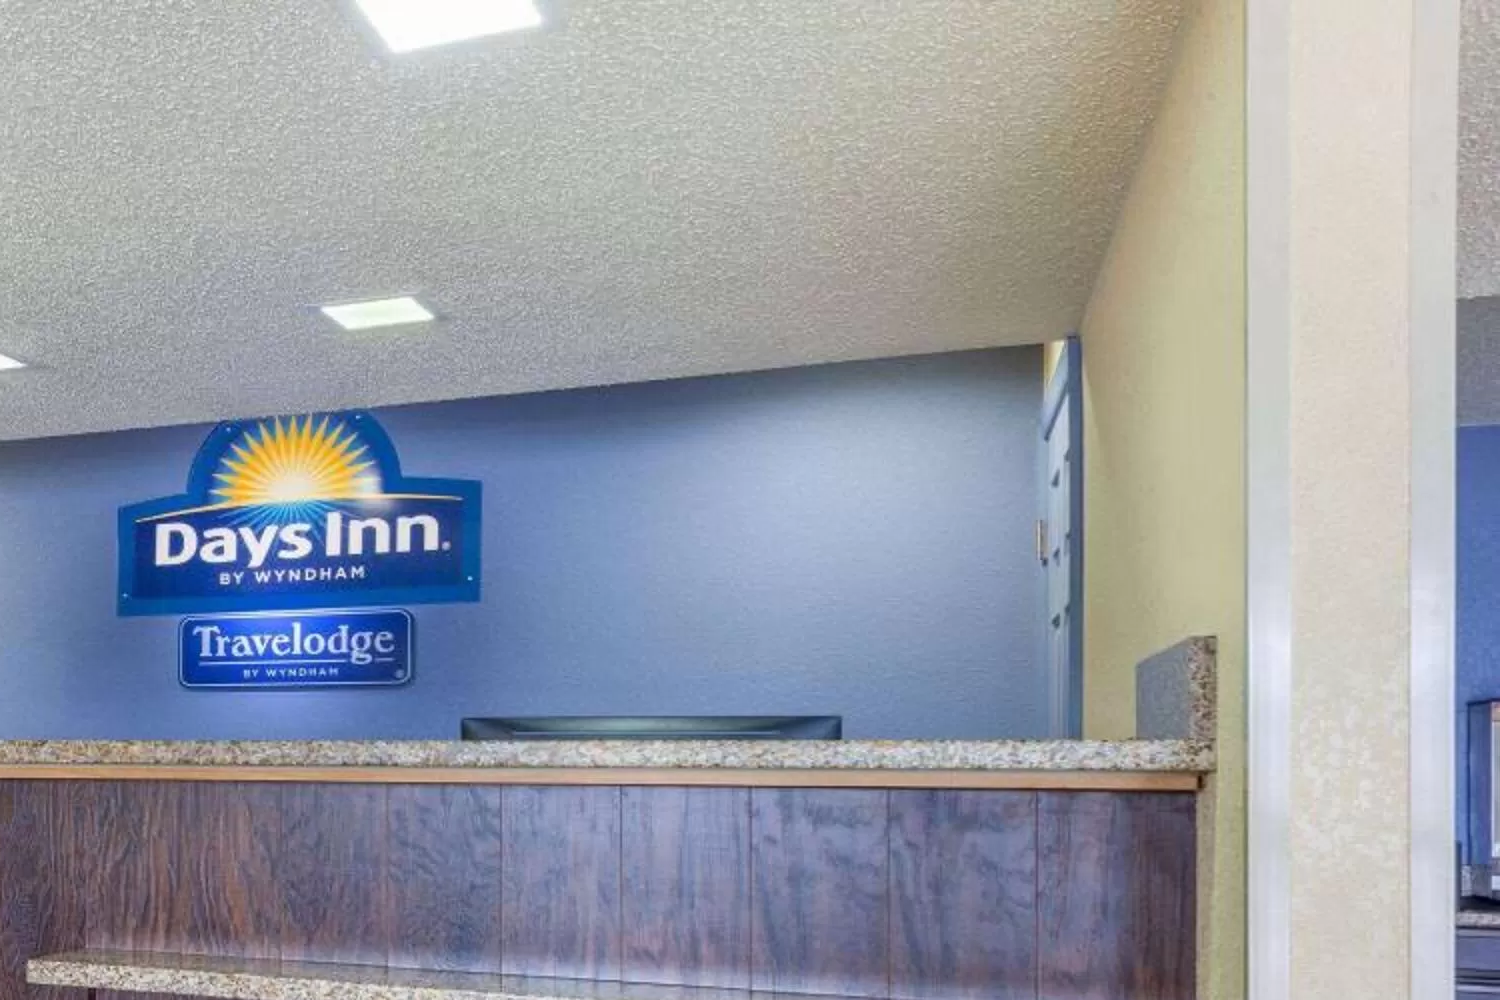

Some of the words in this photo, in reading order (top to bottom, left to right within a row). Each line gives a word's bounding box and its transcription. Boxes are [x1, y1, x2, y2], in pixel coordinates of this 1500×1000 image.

[154, 522, 313, 568] Days
[219, 571, 244, 585] BY
[255, 565, 366, 584] WYNDHAM
[192, 622, 395, 665] Travelodge
[243, 669, 259, 678] BY
[266, 668, 339, 678] WYNDHAM
